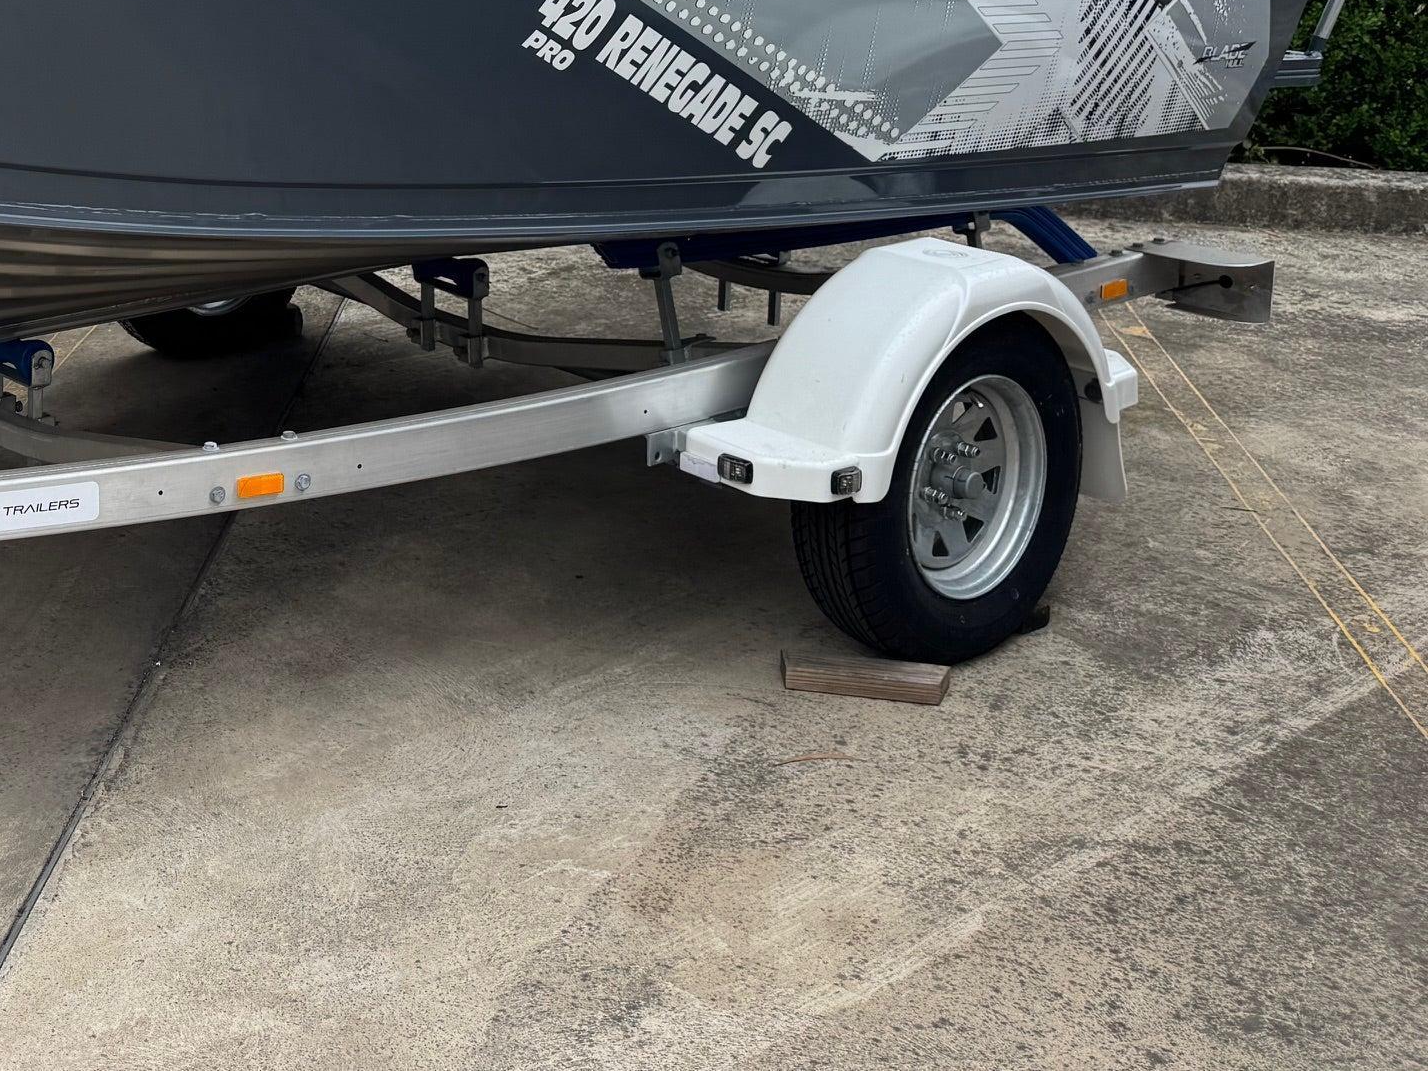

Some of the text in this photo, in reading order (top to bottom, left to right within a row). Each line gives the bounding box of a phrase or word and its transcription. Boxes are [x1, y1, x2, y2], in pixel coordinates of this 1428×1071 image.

[522, 30, 575, 71] PRO
[595, 13, 759, 146] RENEGADE
[735, 110, 793, 169] SC
[3, 498, 80, 516] TRAILERS
